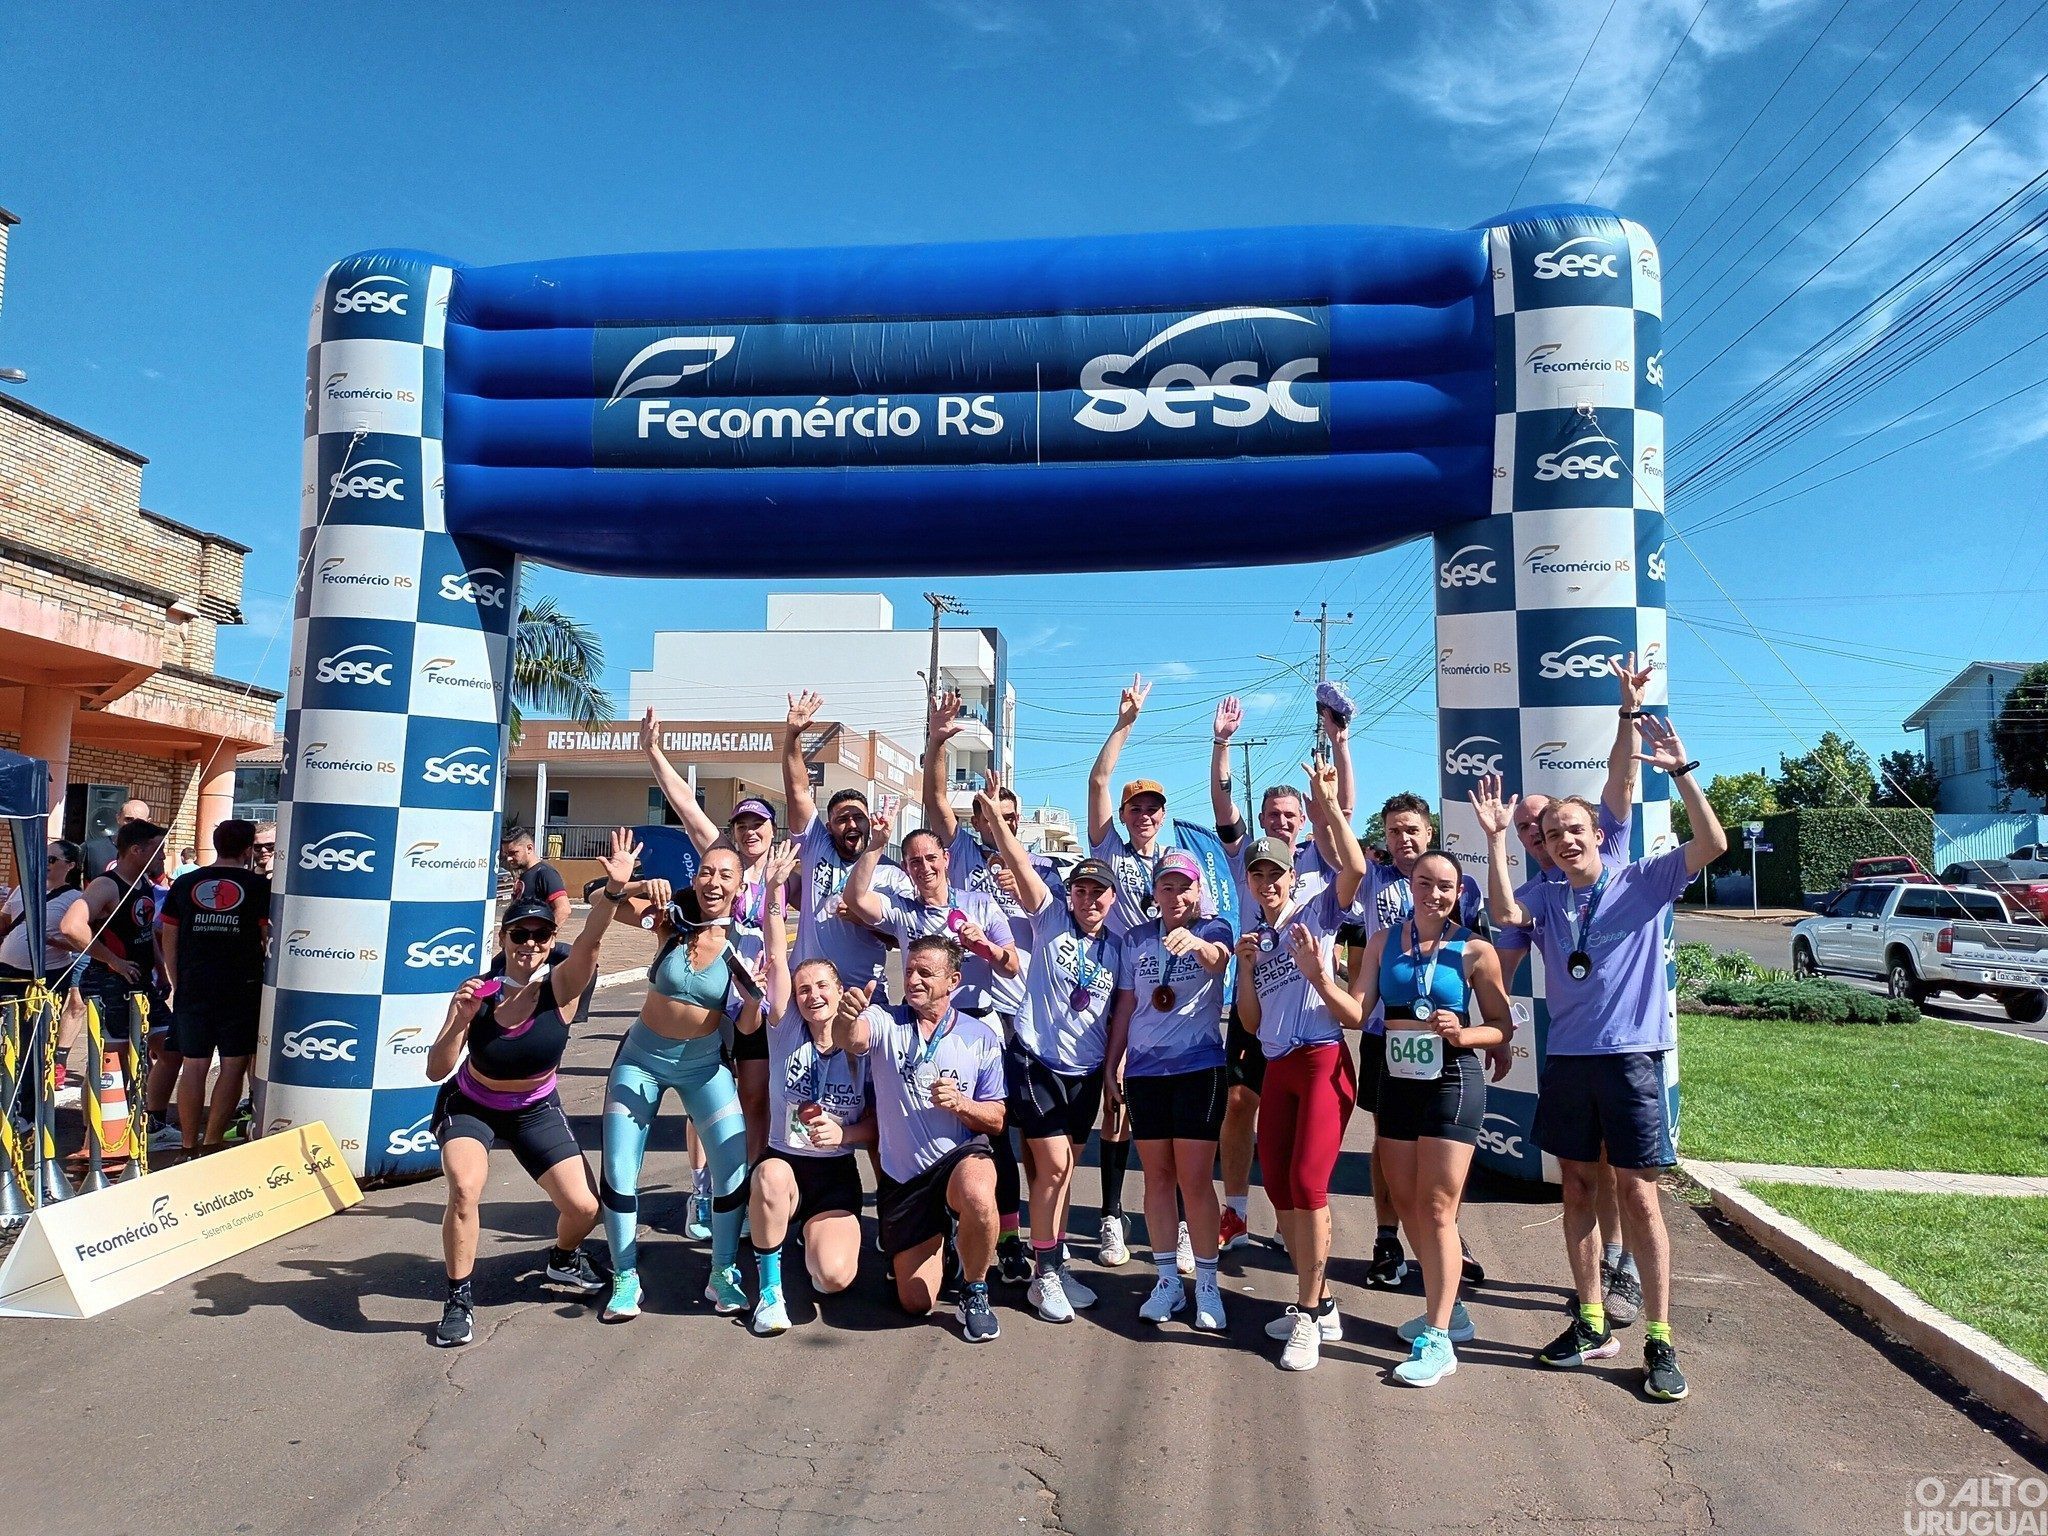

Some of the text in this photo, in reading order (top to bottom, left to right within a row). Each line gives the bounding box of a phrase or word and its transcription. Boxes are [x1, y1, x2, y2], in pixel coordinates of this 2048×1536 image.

[1533, 359, 1630, 374] Fecomércio RS
[328, 387, 415, 403] Fecomércio RS
[1074, 353, 1320, 432] Sesc
[638, 395, 1004, 439] Fecomércio RS
[1532, 559, 1630, 574] Fecomércio RS
[322, 573, 413, 588] Fecomércio RS
[1441, 661, 1512, 675] Fecomércio RS
[428, 672, 503, 692] Fecomércio RS
[546, 731, 642, 751] RESTAURANT
[663, 732, 775, 752] CHURRASCARIA
[305, 758, 396, 773] Fecomércio RS
[1539, 756, 1609, 770] Fecomérci
[411, 857, 488, 869] Fecomércio RS
[288, 945, 356, 960] Fecomércio
[359, 949, 379, 961] RS
[1964, 951, 2048, 964] CHEVROLE
[1390, 1036, 1435, 1064] 648
[1511, 1045, 1530, 1059] RS
[822, 1093, 862, 1107] EDRAS
[340, 1139, 360, 1150] RS
[385, 1128, 440, 1155] Ses
[1476, 1127, 1524, 1159] esc
[75, 1222, 158, 1262] Fecomércio
[158, 1212, 179, 1230] RS
[193, 1187, 254, 1217] Sindicatos
[201, 1210, 264, 1240] Sistema Comércio
